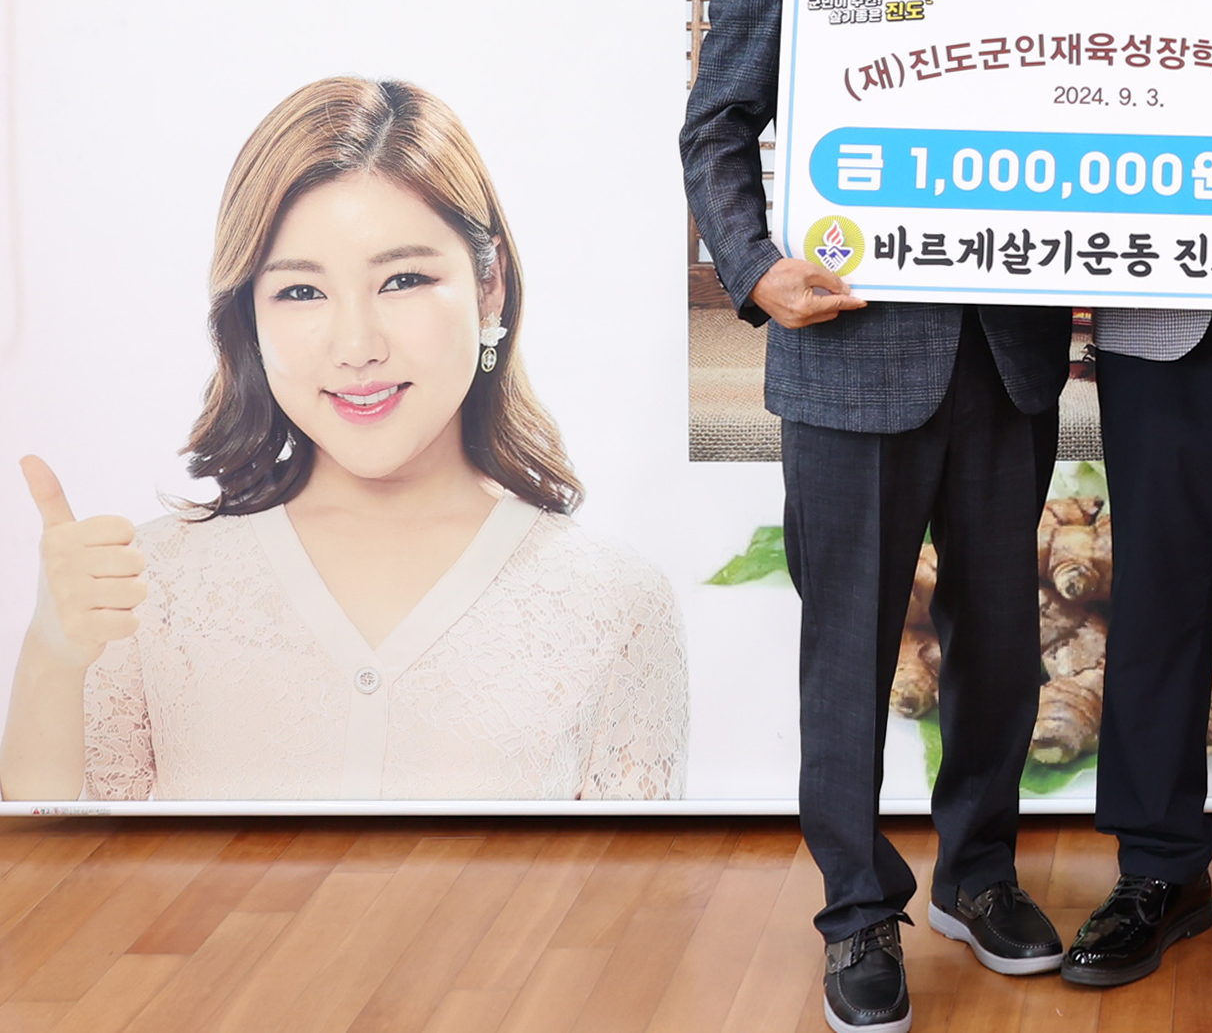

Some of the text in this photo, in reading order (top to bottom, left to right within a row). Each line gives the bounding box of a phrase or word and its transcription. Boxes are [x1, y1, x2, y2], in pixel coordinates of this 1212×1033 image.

[829, 0, 925, 25] 살기좋은 진도
[1053, 85, 1165, 108] 2024. 9. 3.
[837, 143, 884, 192] 금
[873, 225, 1160, 279] 바르게살기운동
